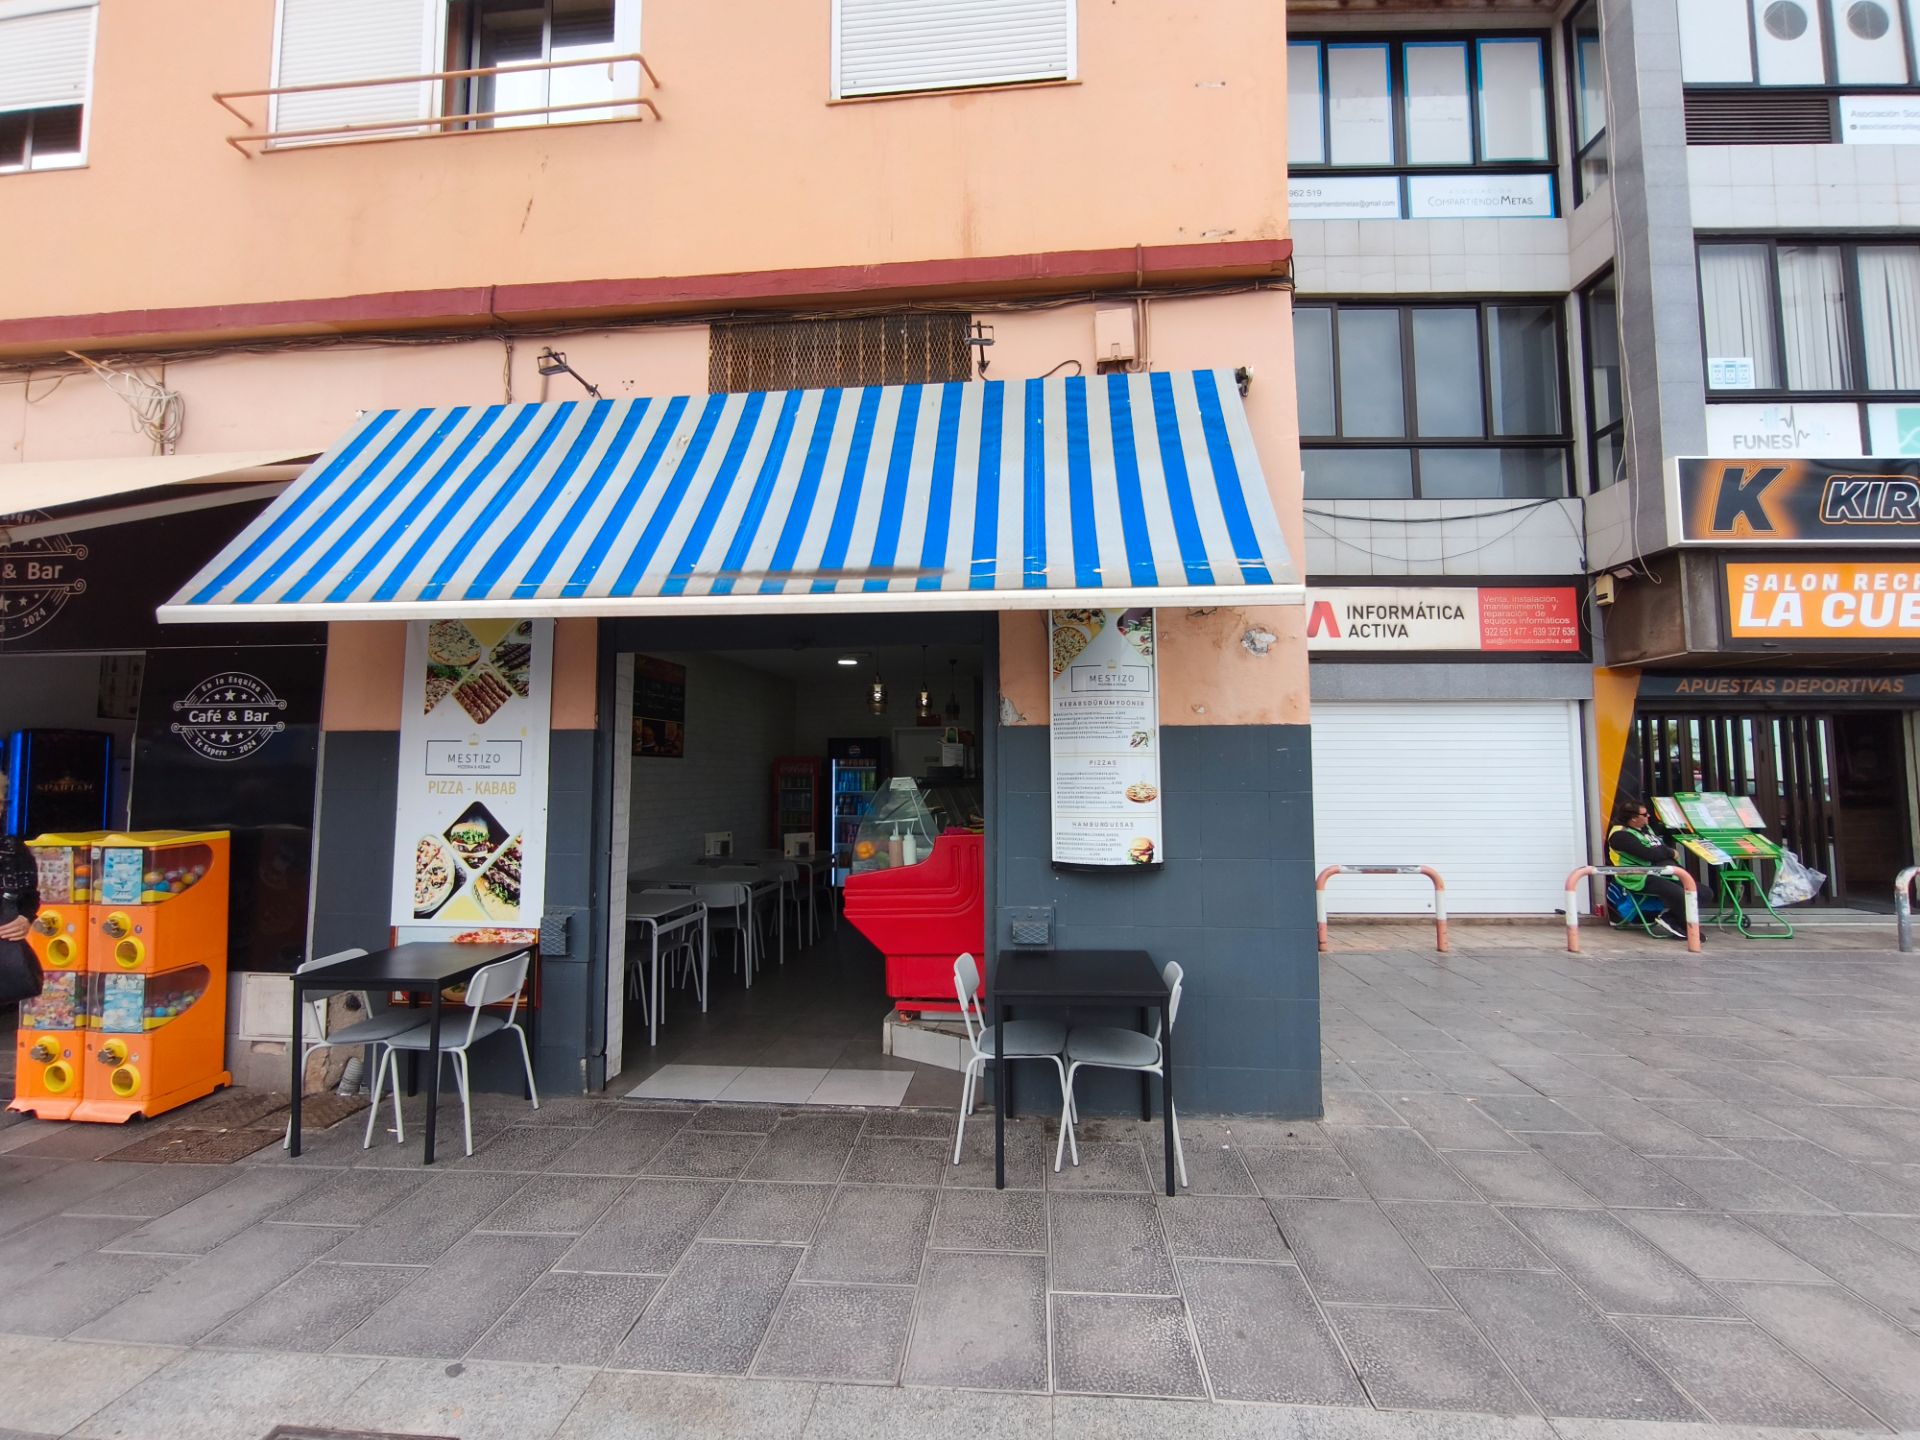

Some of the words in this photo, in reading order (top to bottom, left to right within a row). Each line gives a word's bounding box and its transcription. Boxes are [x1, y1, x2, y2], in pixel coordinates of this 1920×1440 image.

[1289, 189, 1305, 197] 962
[1306, 189, 1322, 197] 519
[1732, 434, 1794, 450] FUNES
[1711, 466, 1787, 533] K
[1825, 481, 1920, 519] KIR
[2, 563, 17, 579] &
[27, 562, 64, 580] Bar
[1743, 573, 1840, 592] SALON
[1346, 601, 1465, 620] INFORMÁTICA
[1483, 603, 1545, 611] mantenimiento
[1535, 610, 1546, 618] de
[1738, 592, 1804, 628] LA
[1820, 592, 1920, 628] CUE
[22, 607, 47, 628] 2024
[1483, 617, 1517, 625] equipos
[1348, 623, 1410, 638] ACTIVA
[1484, 627, 1498, 636] 922
[1513, 627, 1528, 636] 477
[1532, 627, 1547, 636] 639
[1548, 627, 1561, 636] 327
[228, 675, 261, 692] Esquina
[1089, 674, 1135, 683] MESTIZO
[1675, 677, 1777, 694] APUESTAS
[1781, 677, 1905, 694] DEPORTIVAS
[188, 709, 222, 723] Café
[226, 710, 238, 721] &
[244, 709, 270, 722] Bar
[203, 744, 227, 756] Espero
[239, 739, 258, 754] 2024
[447, 753, 501, 763] MESTIZO
[427, 780, 464, 795] PIZZA
[474, 781, 517, 795] KABAB
